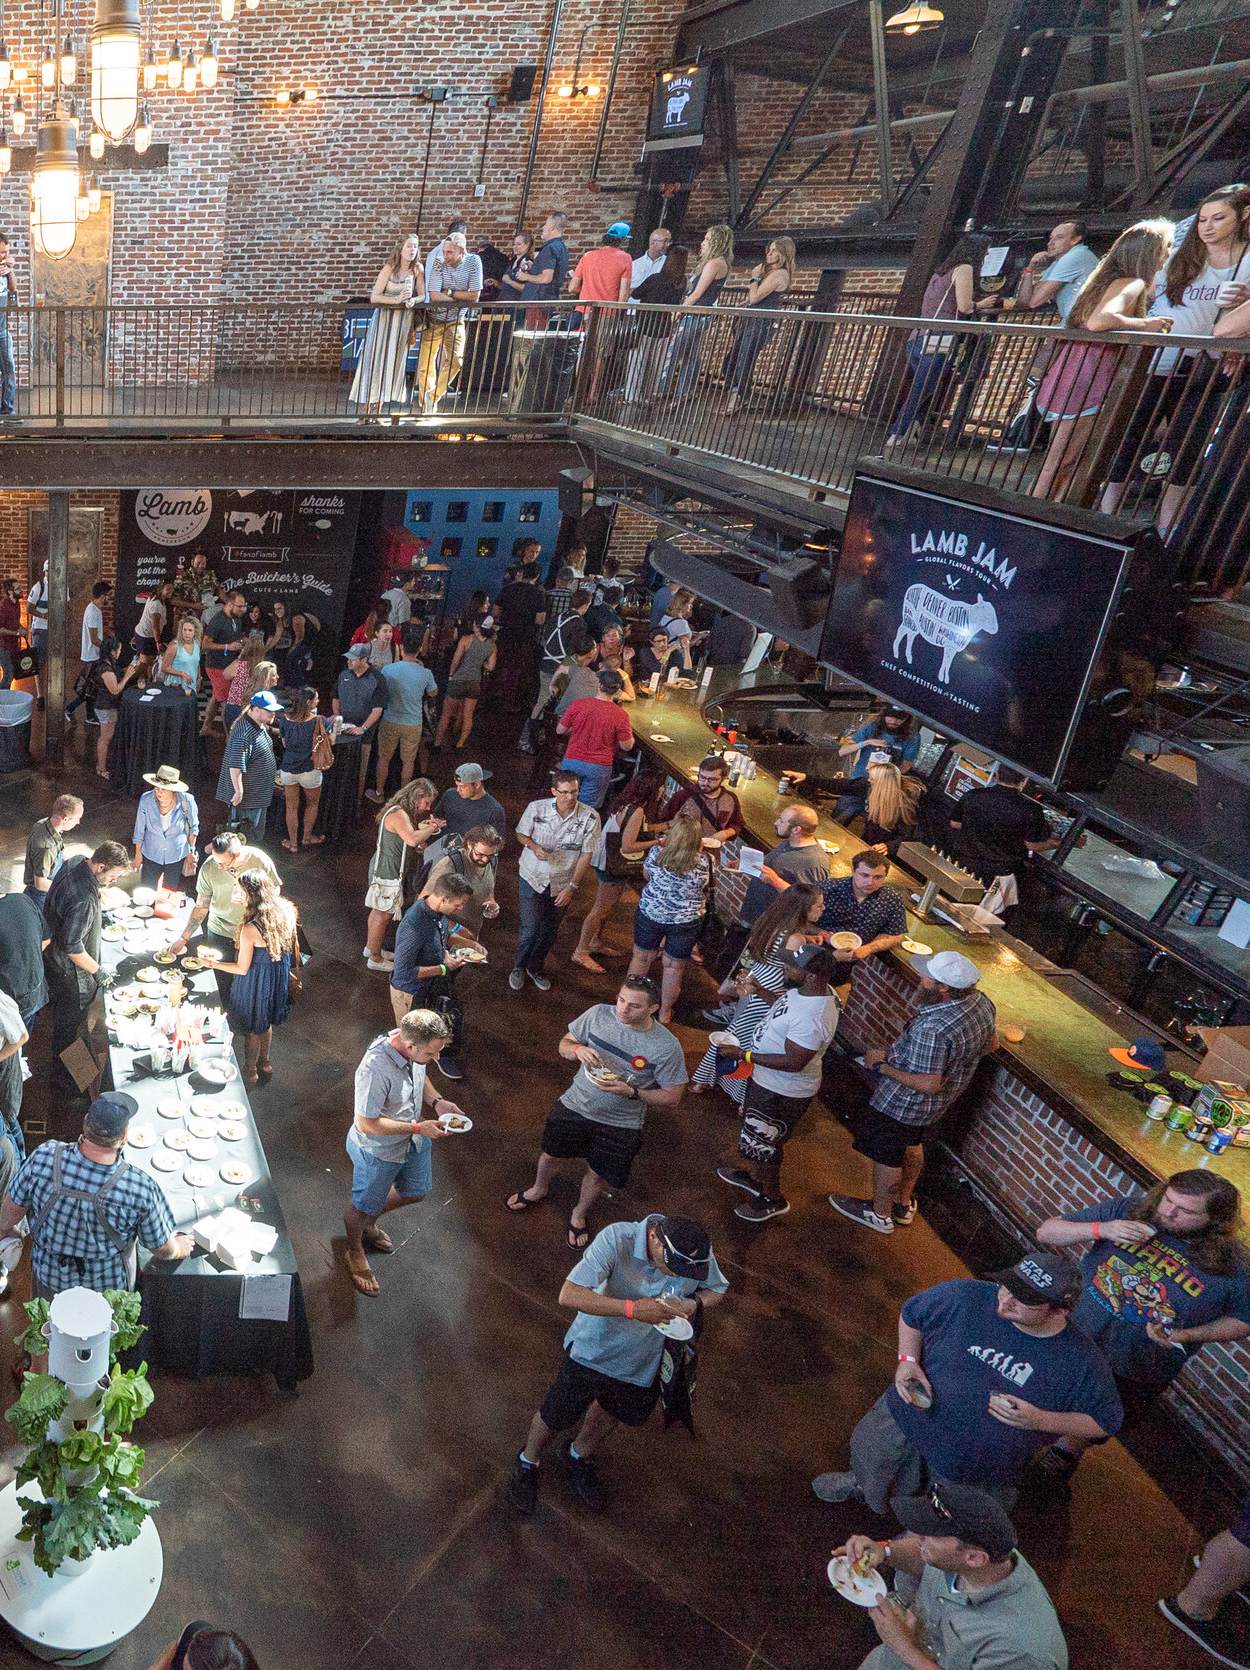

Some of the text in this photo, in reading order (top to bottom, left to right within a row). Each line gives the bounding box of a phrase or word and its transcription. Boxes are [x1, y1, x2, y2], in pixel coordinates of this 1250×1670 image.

[1184, 284, 1221, 300] Potat
[138, 493, 208, 520] Lamb
[300, 495, 346, 507] shanks
[137, 556, 166, 566] you've
[137, 567, 167, 577] got the
[910, 530, 1018, 590] LAMB JAM
[924, 556, 992, 585] GLOBAL FLAVORS TOUR
[137, 578, 160, 587] chops
[221, 571, 334, 596] The Butcher's Guide
[922, 592, 947, 619] DENVER
[880, 660, 981, 713] CHEF COMPETITION TASTING
[1151, 1239, 1190, 1267] SUPER
[1018, 1262, 1050, 1288] WARS
[1023, 1260, 1053, 1286] STAR
